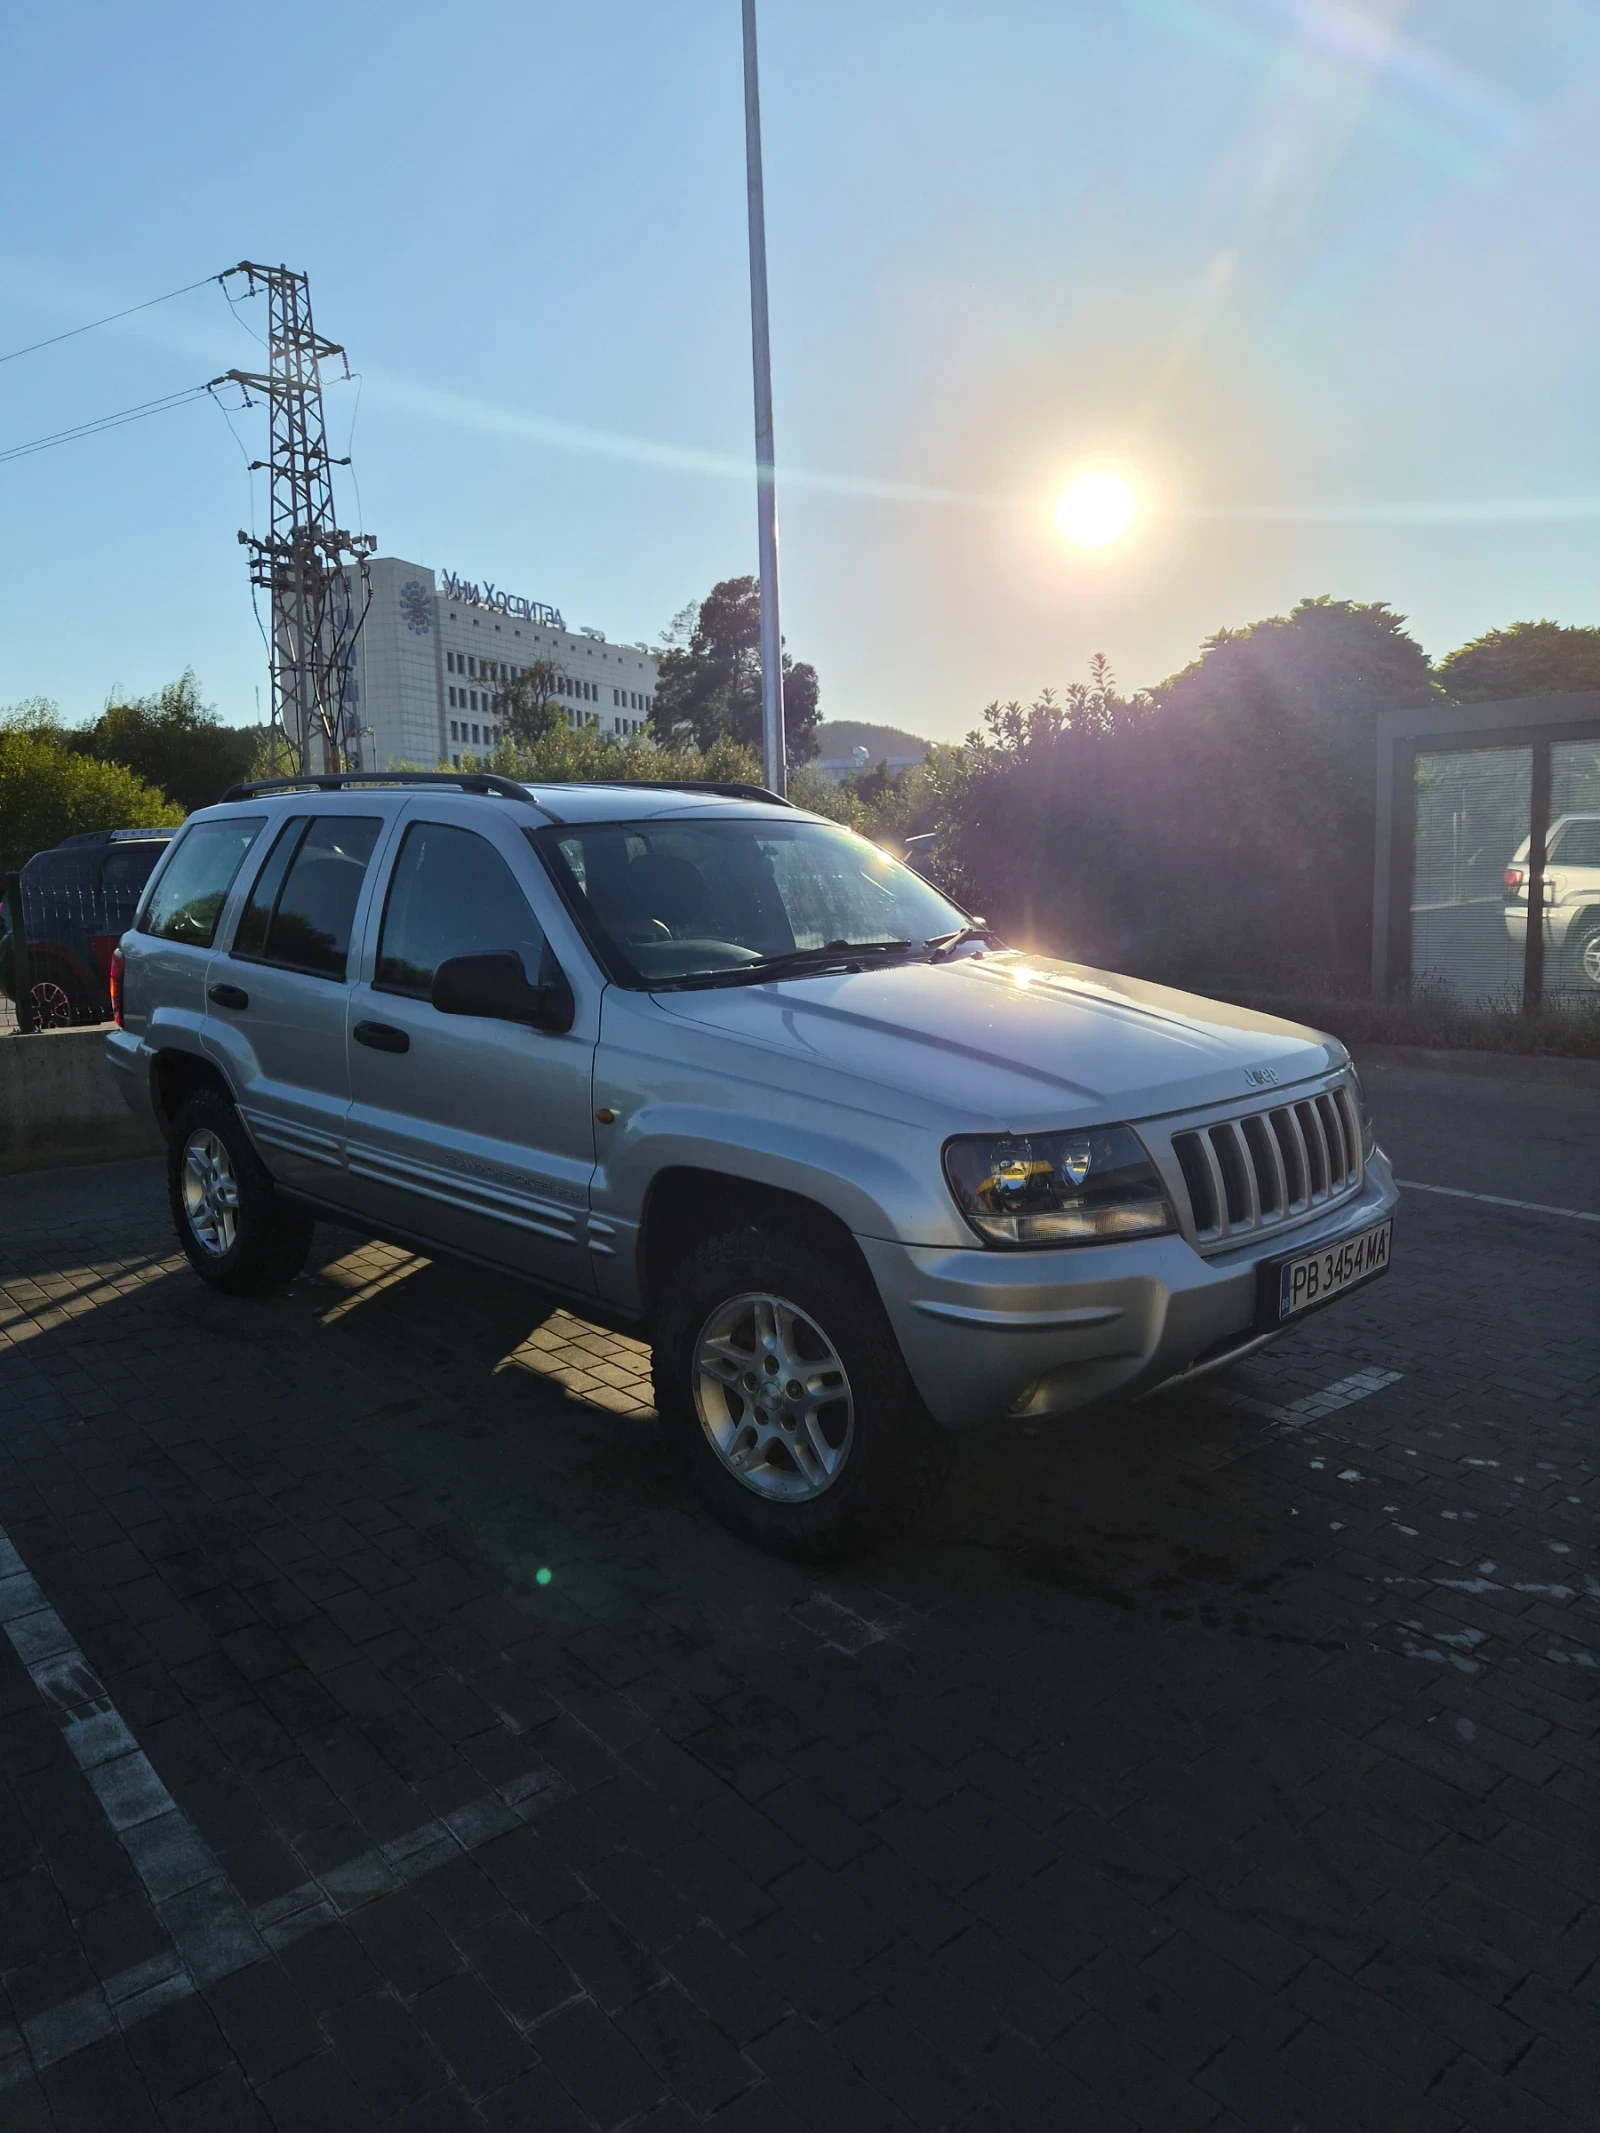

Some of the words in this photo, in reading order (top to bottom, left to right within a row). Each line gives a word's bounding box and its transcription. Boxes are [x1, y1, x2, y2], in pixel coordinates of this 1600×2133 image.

[113, 829, 162, 837] DUSTER
[1244, 1067, 1278, 1087] Jeep
[1293, 1260, 1319, 1305] PB
[1323, 1239, 1364, 1290] 3454
[1366, 1228, 1385, 1269] MA
